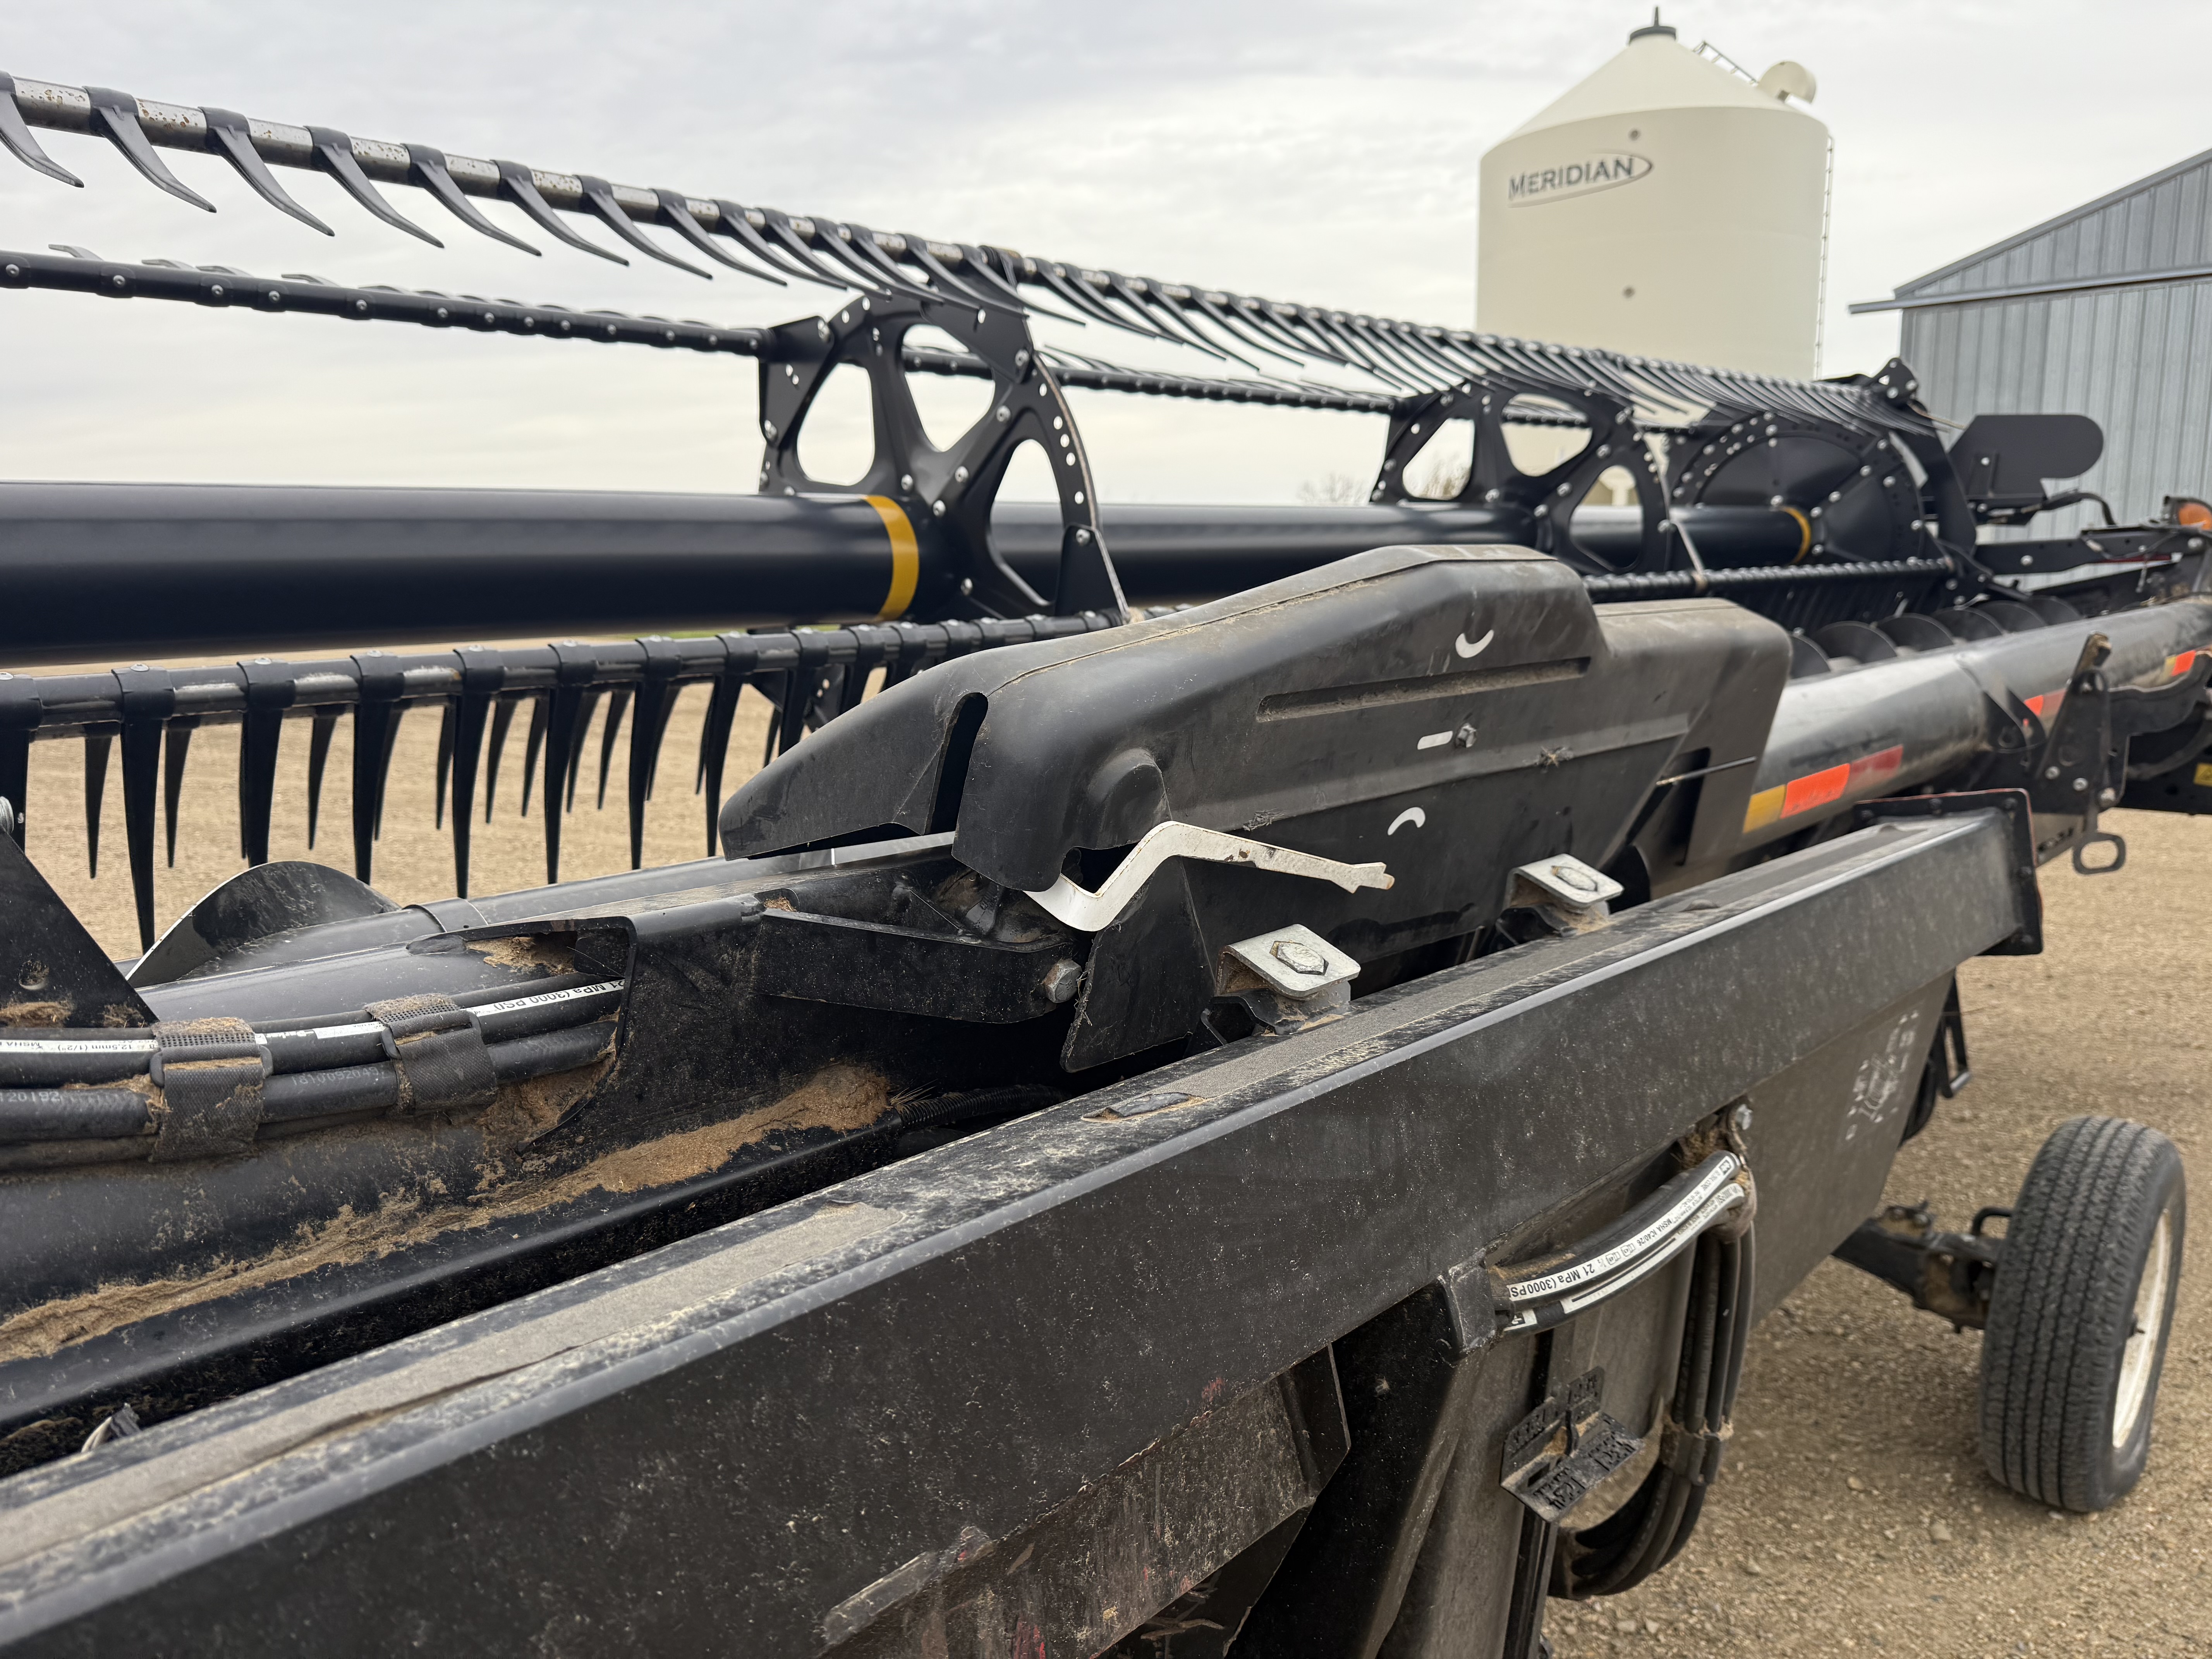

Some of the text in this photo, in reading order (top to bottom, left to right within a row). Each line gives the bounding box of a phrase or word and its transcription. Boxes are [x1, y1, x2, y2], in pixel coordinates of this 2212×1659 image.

[1508, 157, 1633, 200] MERIDIAN
[573, 983, 606, 994] MPa
[529, 991, 570, 1004] (3000
[266, 1030, 307, 1039] Parker
[1656, 1218, 1672, 1232] MSHA
[1637, 1229, 1657, 1246] IC40/26
[1557, 1269, 1581, 1283] MPa
[1582, 1263, 1595, 1276] 21
